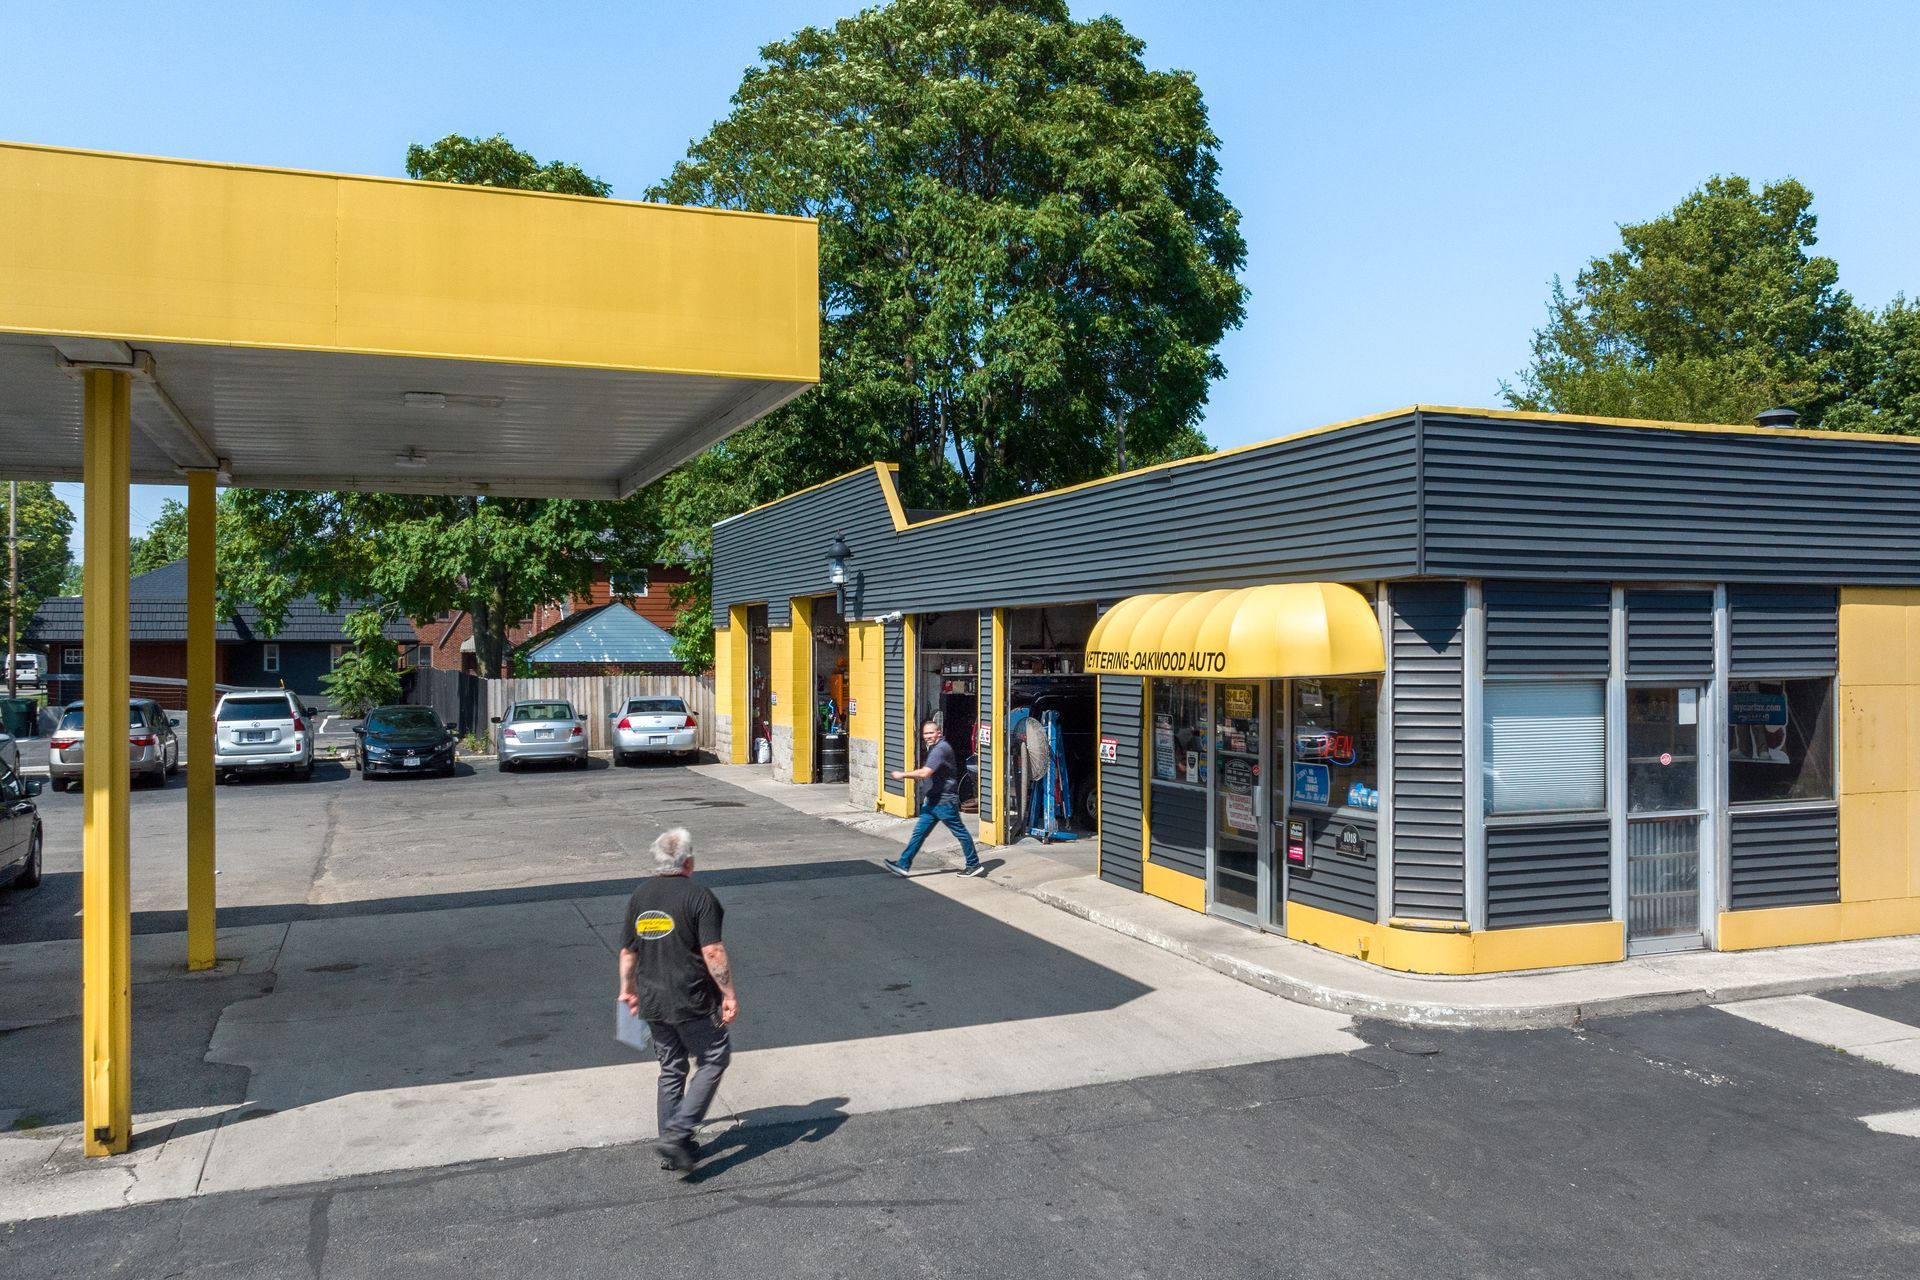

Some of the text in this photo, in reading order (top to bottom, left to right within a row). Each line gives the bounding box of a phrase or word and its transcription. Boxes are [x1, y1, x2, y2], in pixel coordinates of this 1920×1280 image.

[1188, 652, 1226, 672] AUTO
[1318, 735, 1354, 759] OPEN
[1343, 831, 1357, 844] 1018
